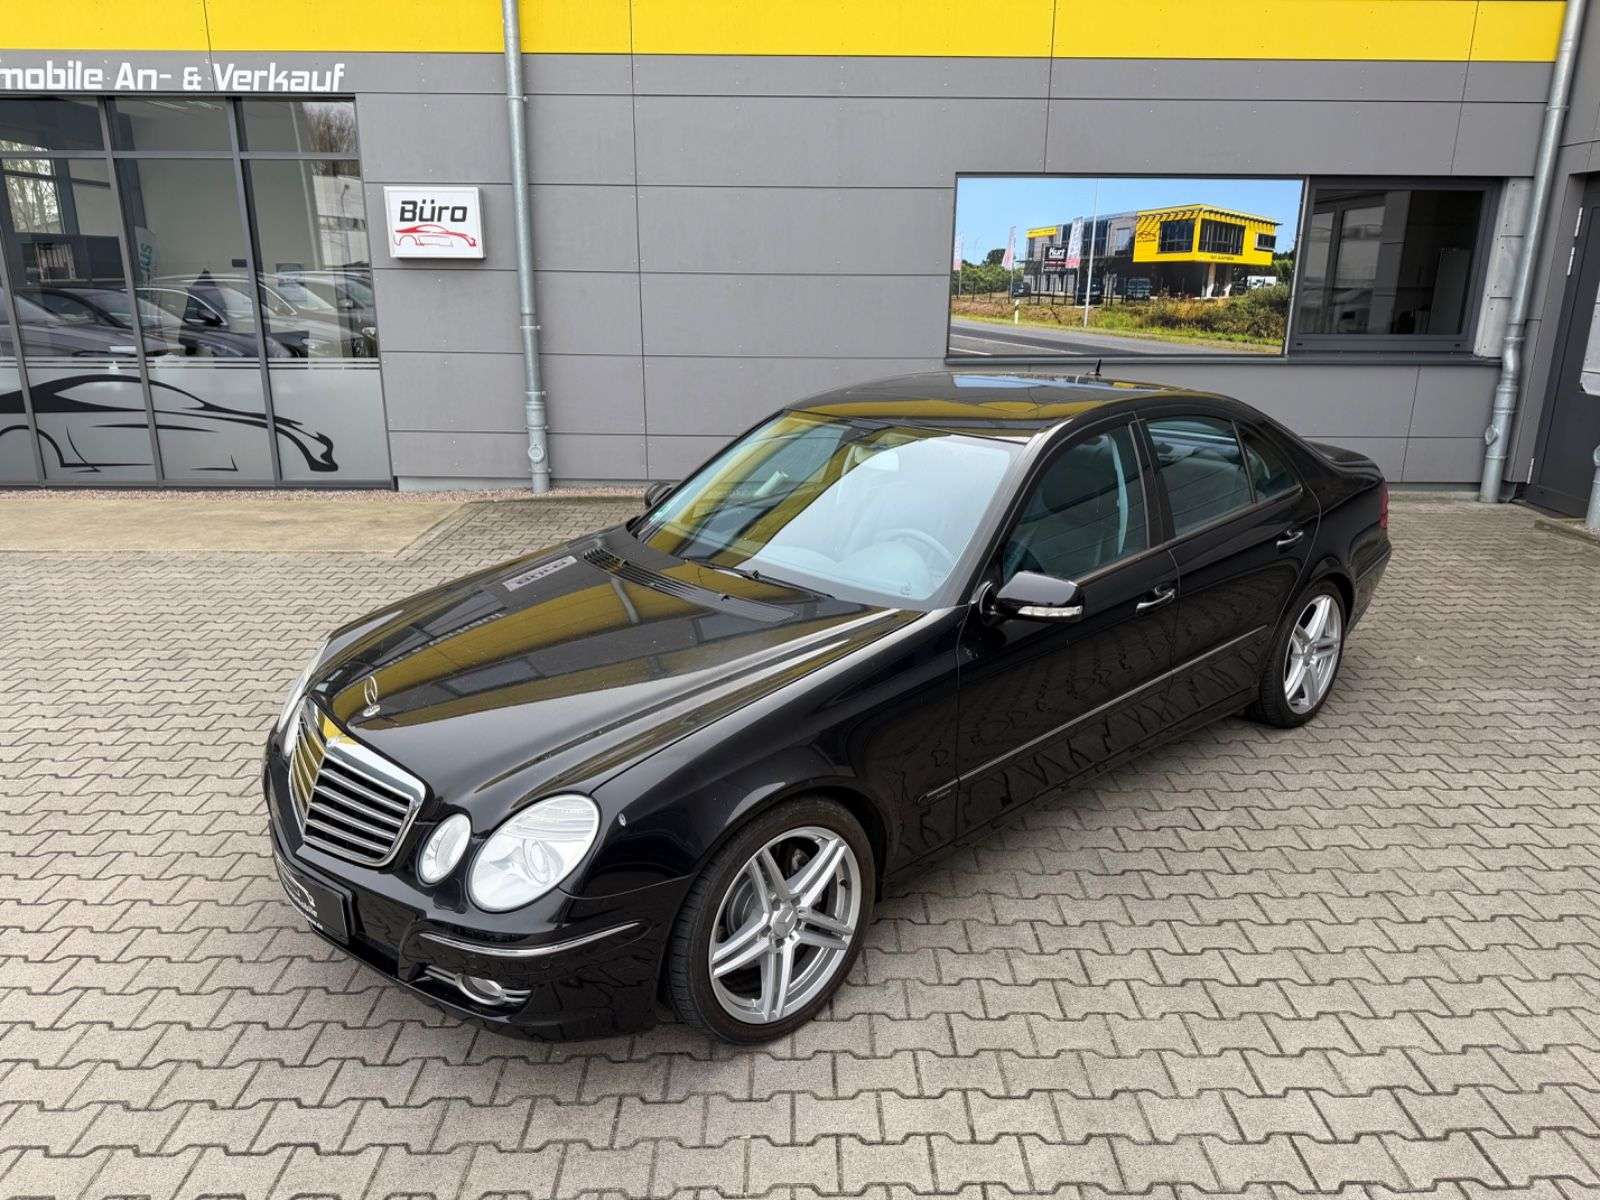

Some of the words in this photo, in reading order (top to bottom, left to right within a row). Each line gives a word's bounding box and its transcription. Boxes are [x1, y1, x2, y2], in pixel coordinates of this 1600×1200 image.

[0, 60, 103, 90] mobile
[114, 62, 172, 90] An-
[183, 67, 201, 91] &
[213, 62, 345, 92] Verkauf
[399, 199, 467, 222] Büro
